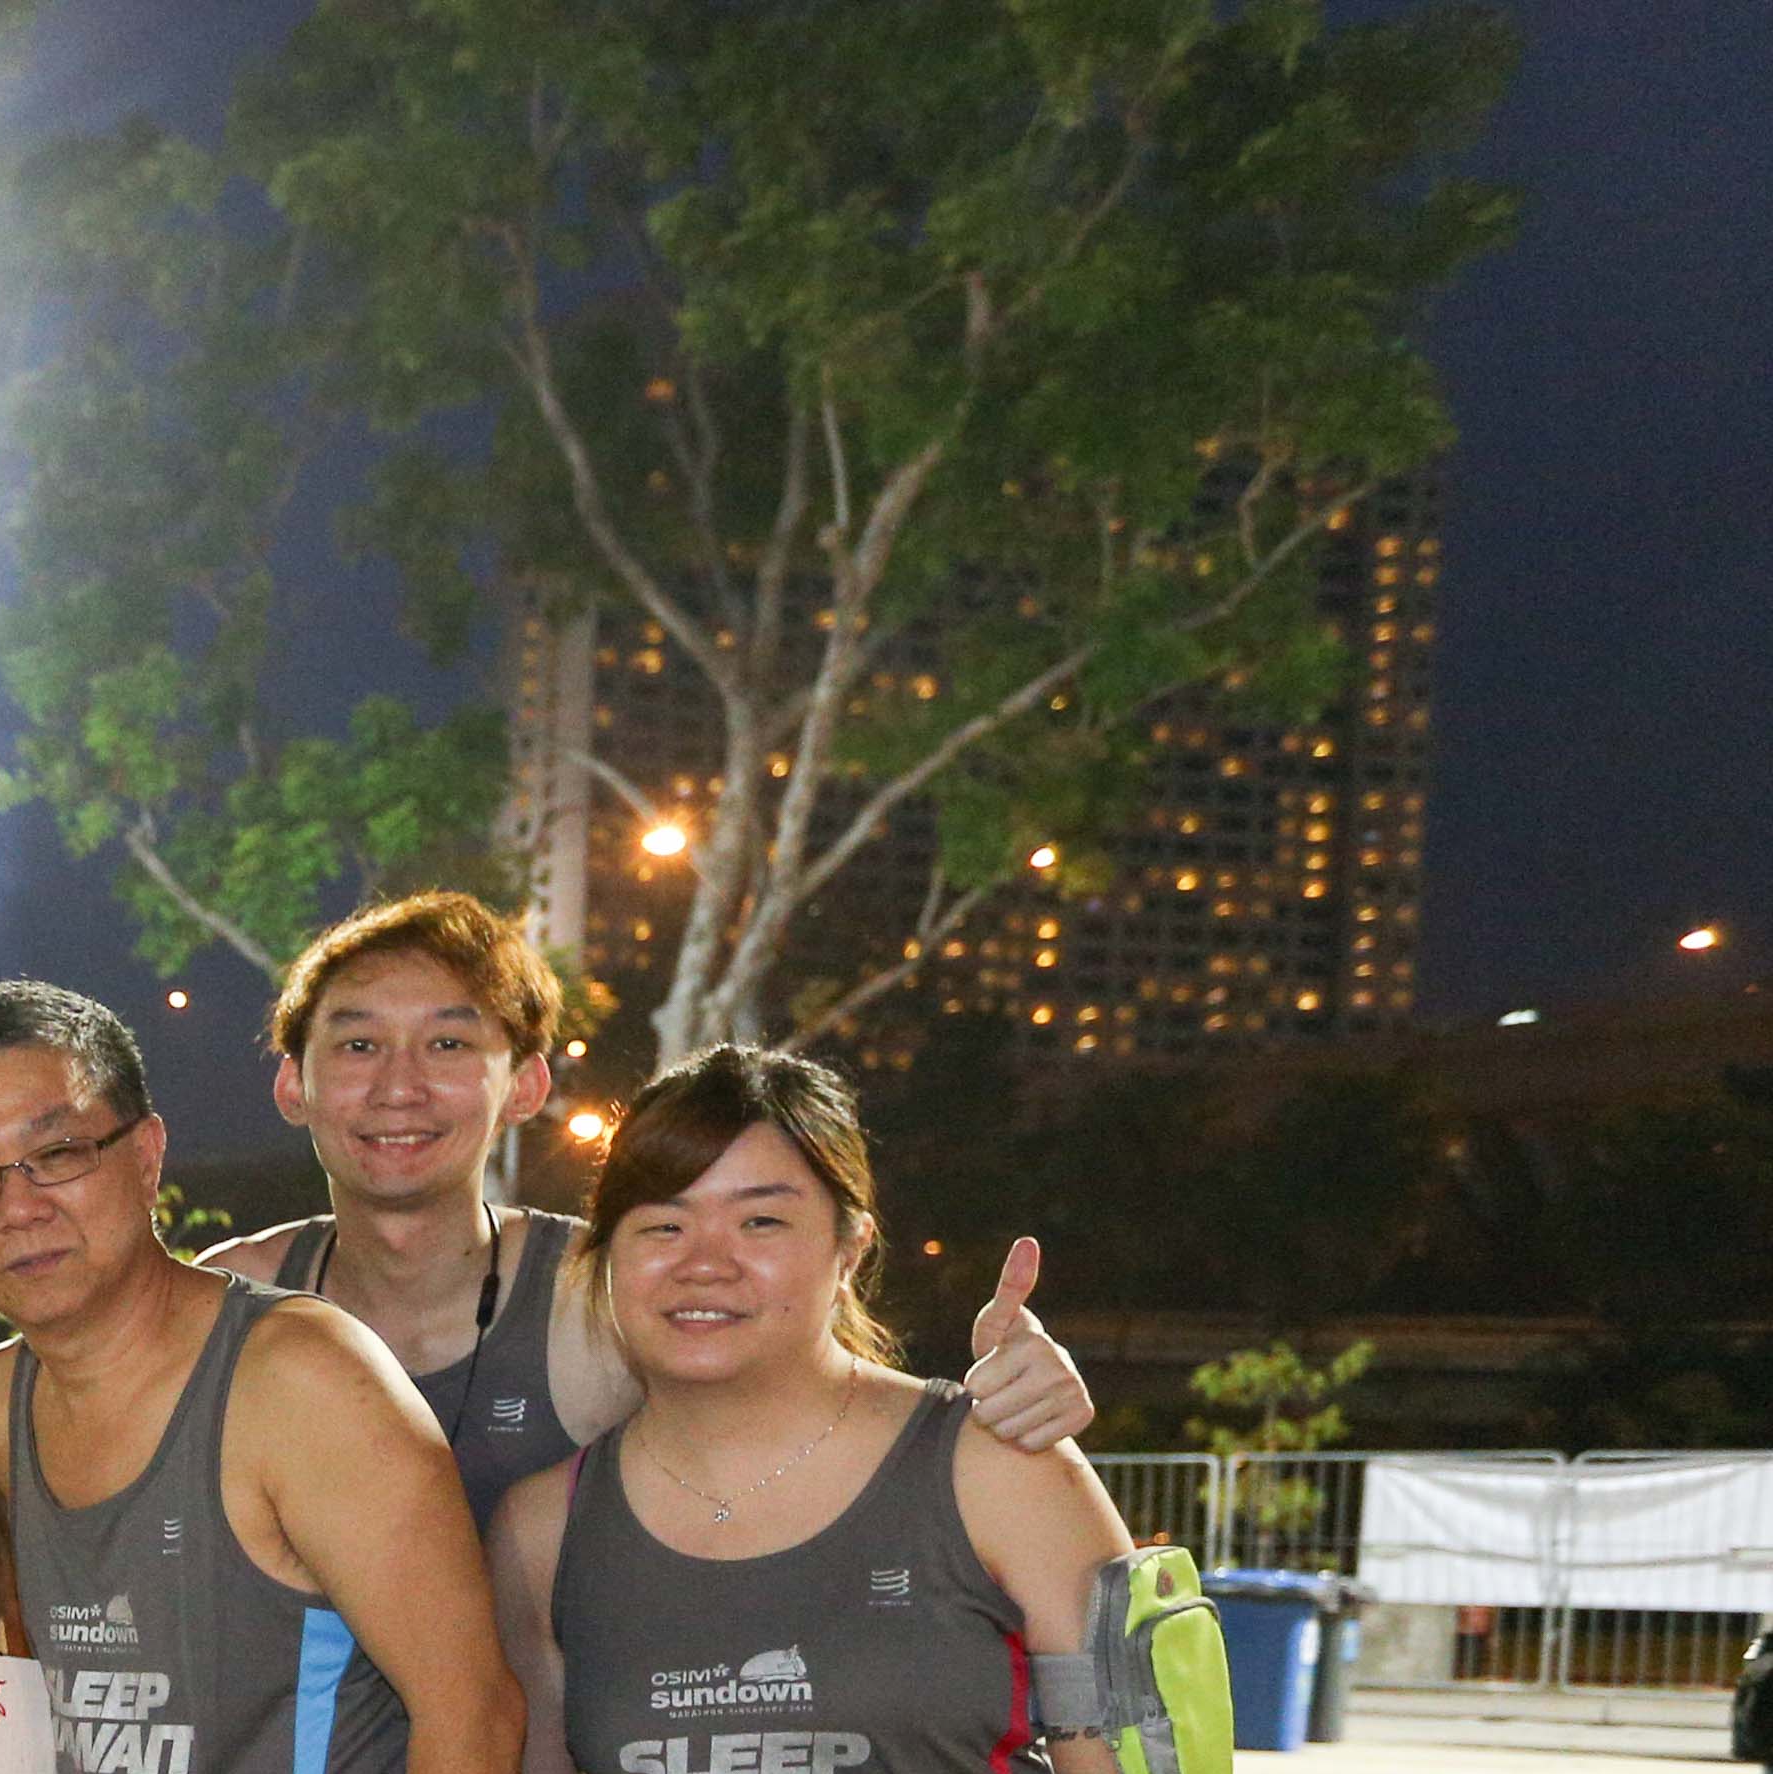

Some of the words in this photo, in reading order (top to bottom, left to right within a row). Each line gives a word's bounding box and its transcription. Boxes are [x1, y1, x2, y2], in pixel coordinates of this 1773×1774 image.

[49, 1605, 90, 1621] OSIM
[49, 1621, 139, 1644] sundown
[651, 1669, 711, 1687] OSIM
[46, 1668, 172, 1720] LEEP
[650, 1679, 813, 1710] sundown
